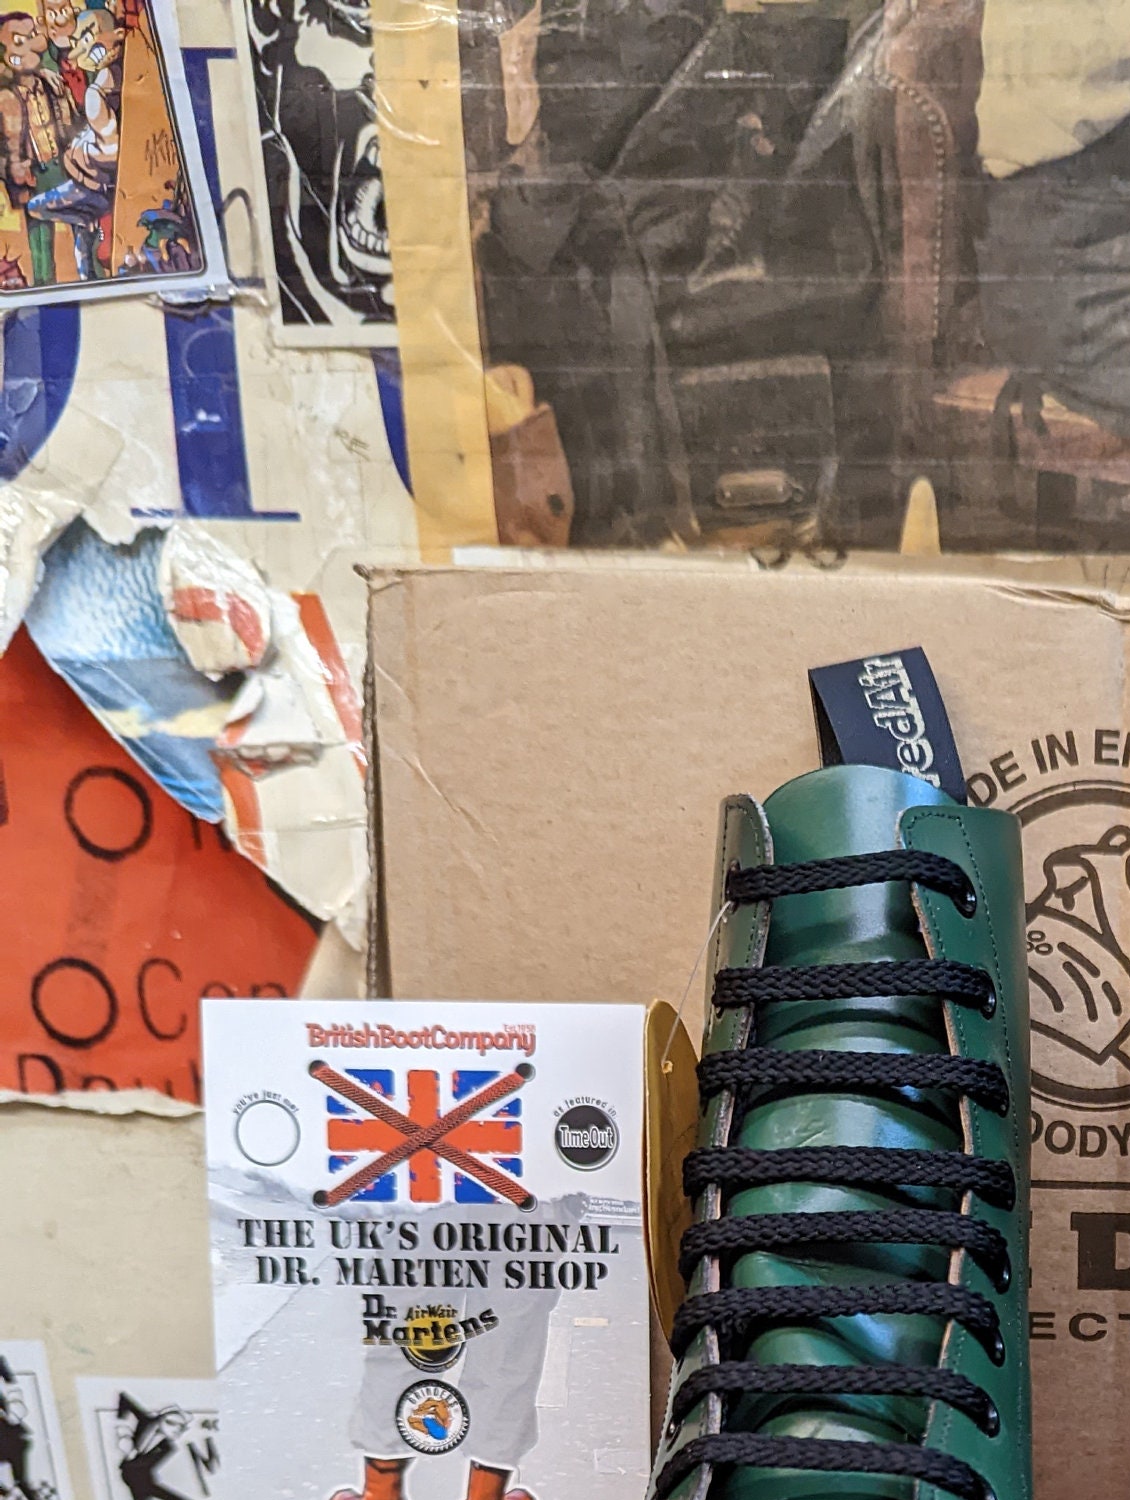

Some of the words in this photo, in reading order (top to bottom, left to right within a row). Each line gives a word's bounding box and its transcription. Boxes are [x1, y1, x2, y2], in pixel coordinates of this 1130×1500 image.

[1031, 730, 1079, 775] IN
[306, 1022, 537, 1057] BritishBootCompany
[237, 1219, 315, 1248] THE
[329, 1220, 420, 1250] UK'S
[433, 1223, 619, 1254] ORIGINAL
[256, 1256, 320, 1285] DR.
[335, 1257, 491, 1289] MARTEN
[505, 1260, 608, 1291] SHOP
[362, 1307, 500, 1345] Martens
